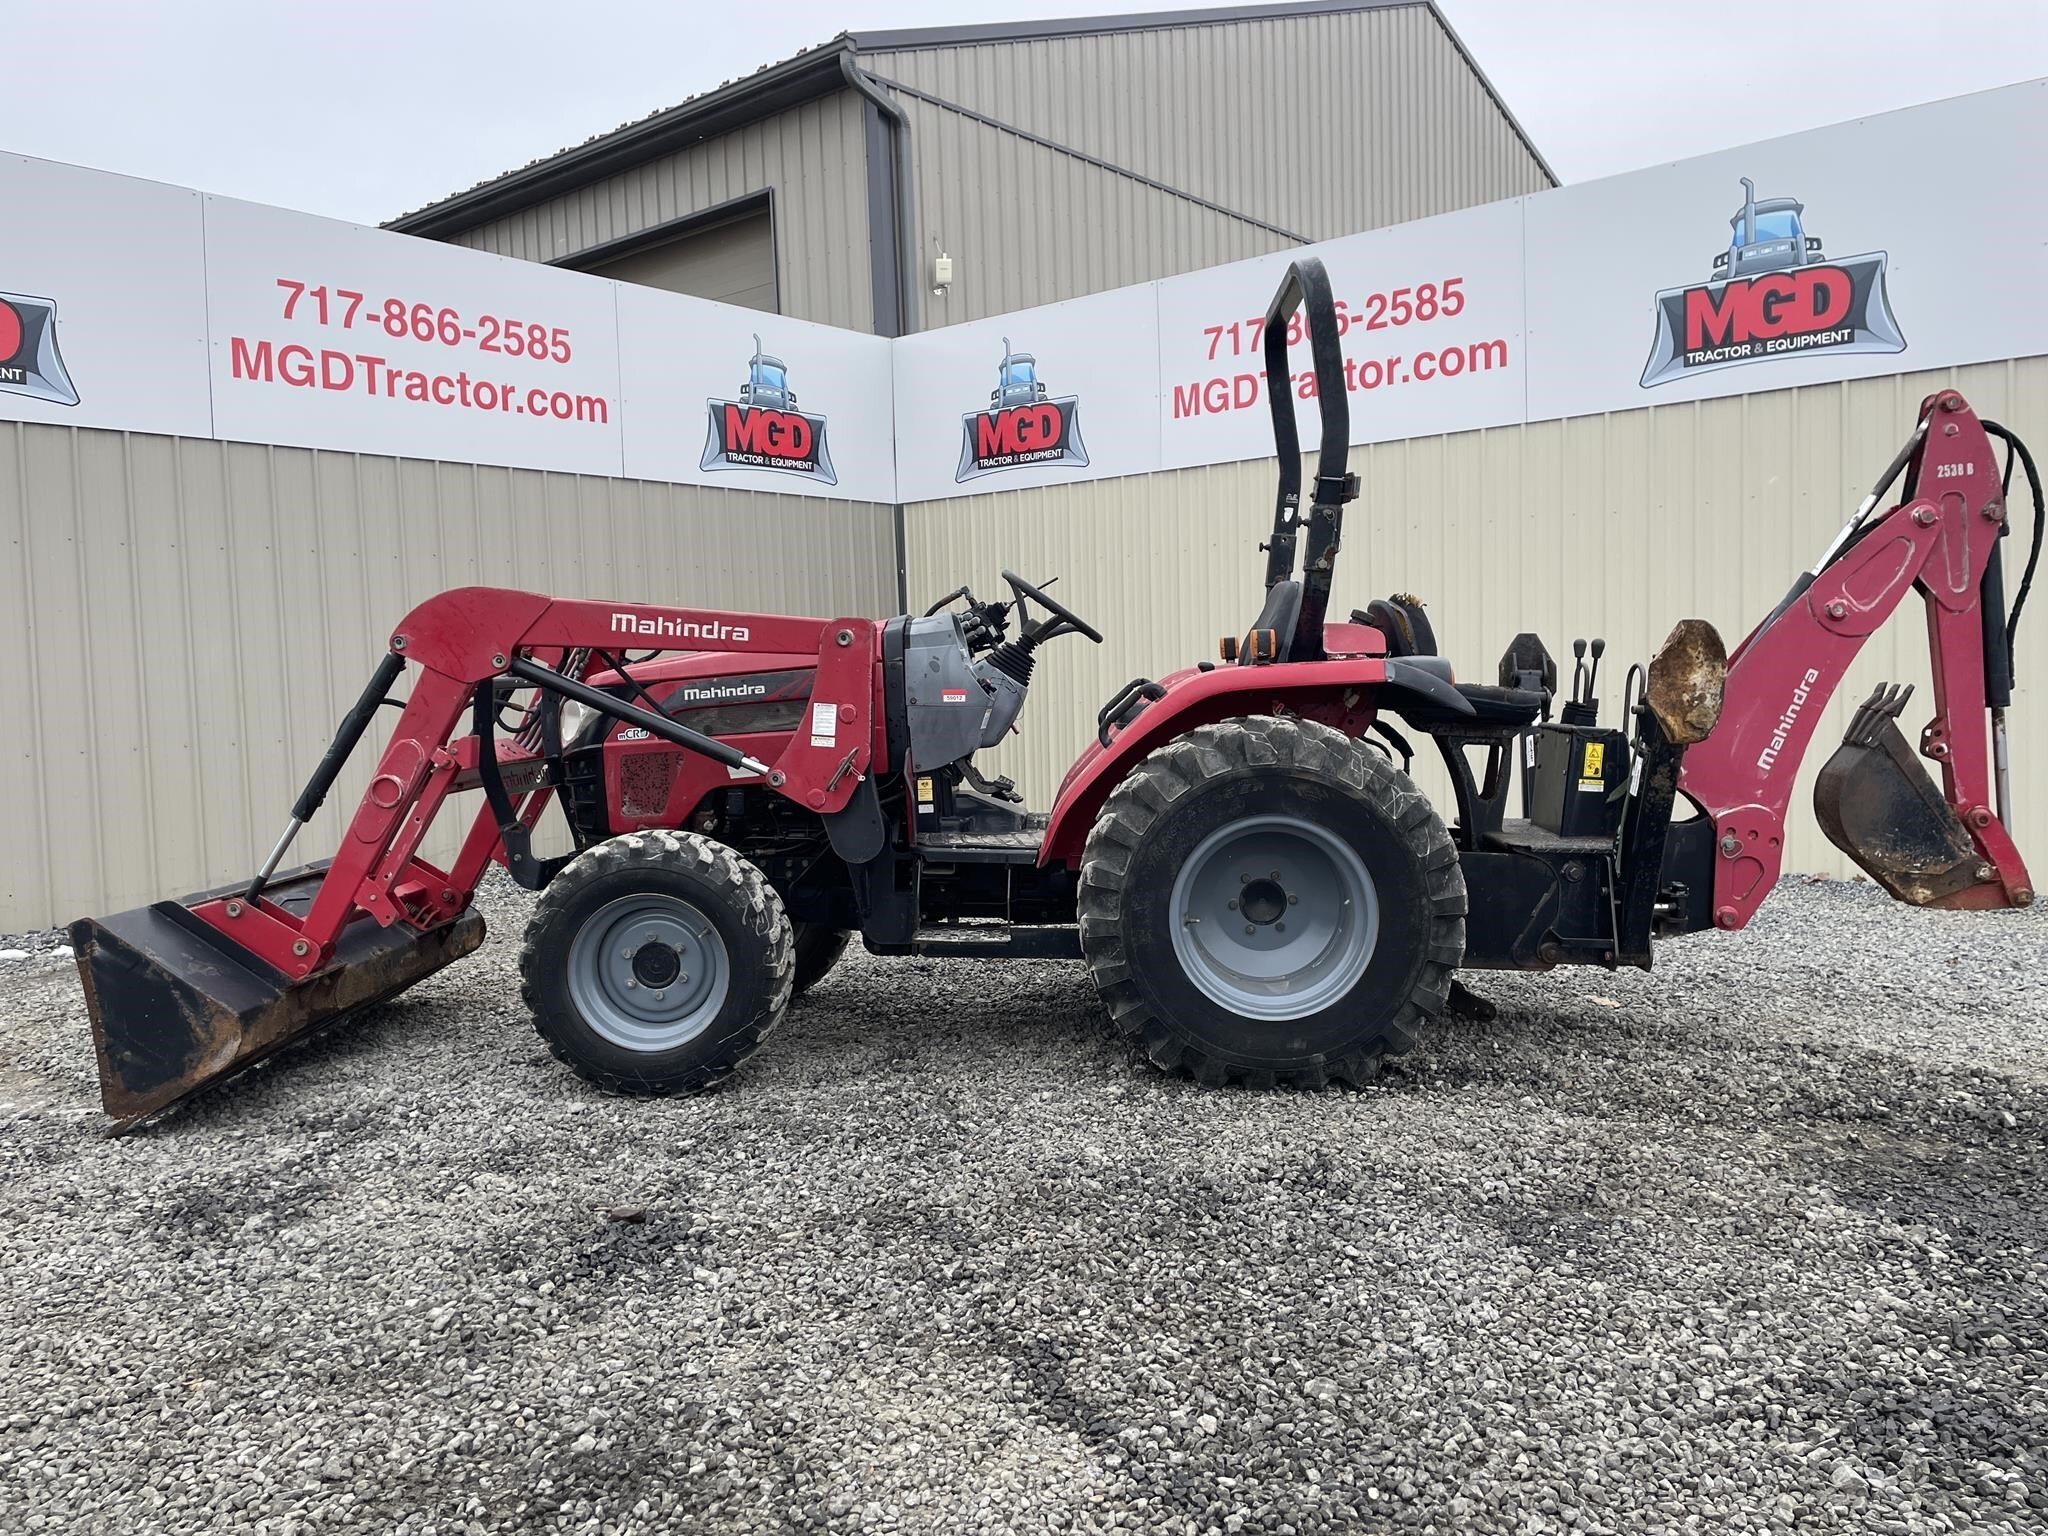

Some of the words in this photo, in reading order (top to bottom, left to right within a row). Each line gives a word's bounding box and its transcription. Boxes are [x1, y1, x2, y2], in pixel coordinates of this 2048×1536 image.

[276, 278, 572, 364] 717-866-2585
[1203, 277, 1466, 360] 71786-2585
[1685, 267, 1851, 350] MGD
[1686, 340, 1751, 364] TRACTOR
[1754, 342, 1764, 354] &
[1766, 328, 1852, 353] EQUIPMENT
[230, 336, 608, 424] MGDTractor.com
[725, 404, 812, 458] MGD
[978, 404, 1062, 457] MGD
[727, 452, 764, 465] TRACTOR
[764, 457, 770, 465] &
[771, 457, 813, 470] EQUIPMENT
[980, 456, 1013, 468] TRACTOR
[1013, 455, 1019, 463] &
[1020, 449, 1062, 462] EQUIPMENT
[1937, 463, 1964, 478] 2538
[1966, 462, 1974, 476] B
[611, 613, 750, 642] Mahindra
[684, 684, 766, 701] Mahindra
[1756, 668, 1819, 771] Mahindra
